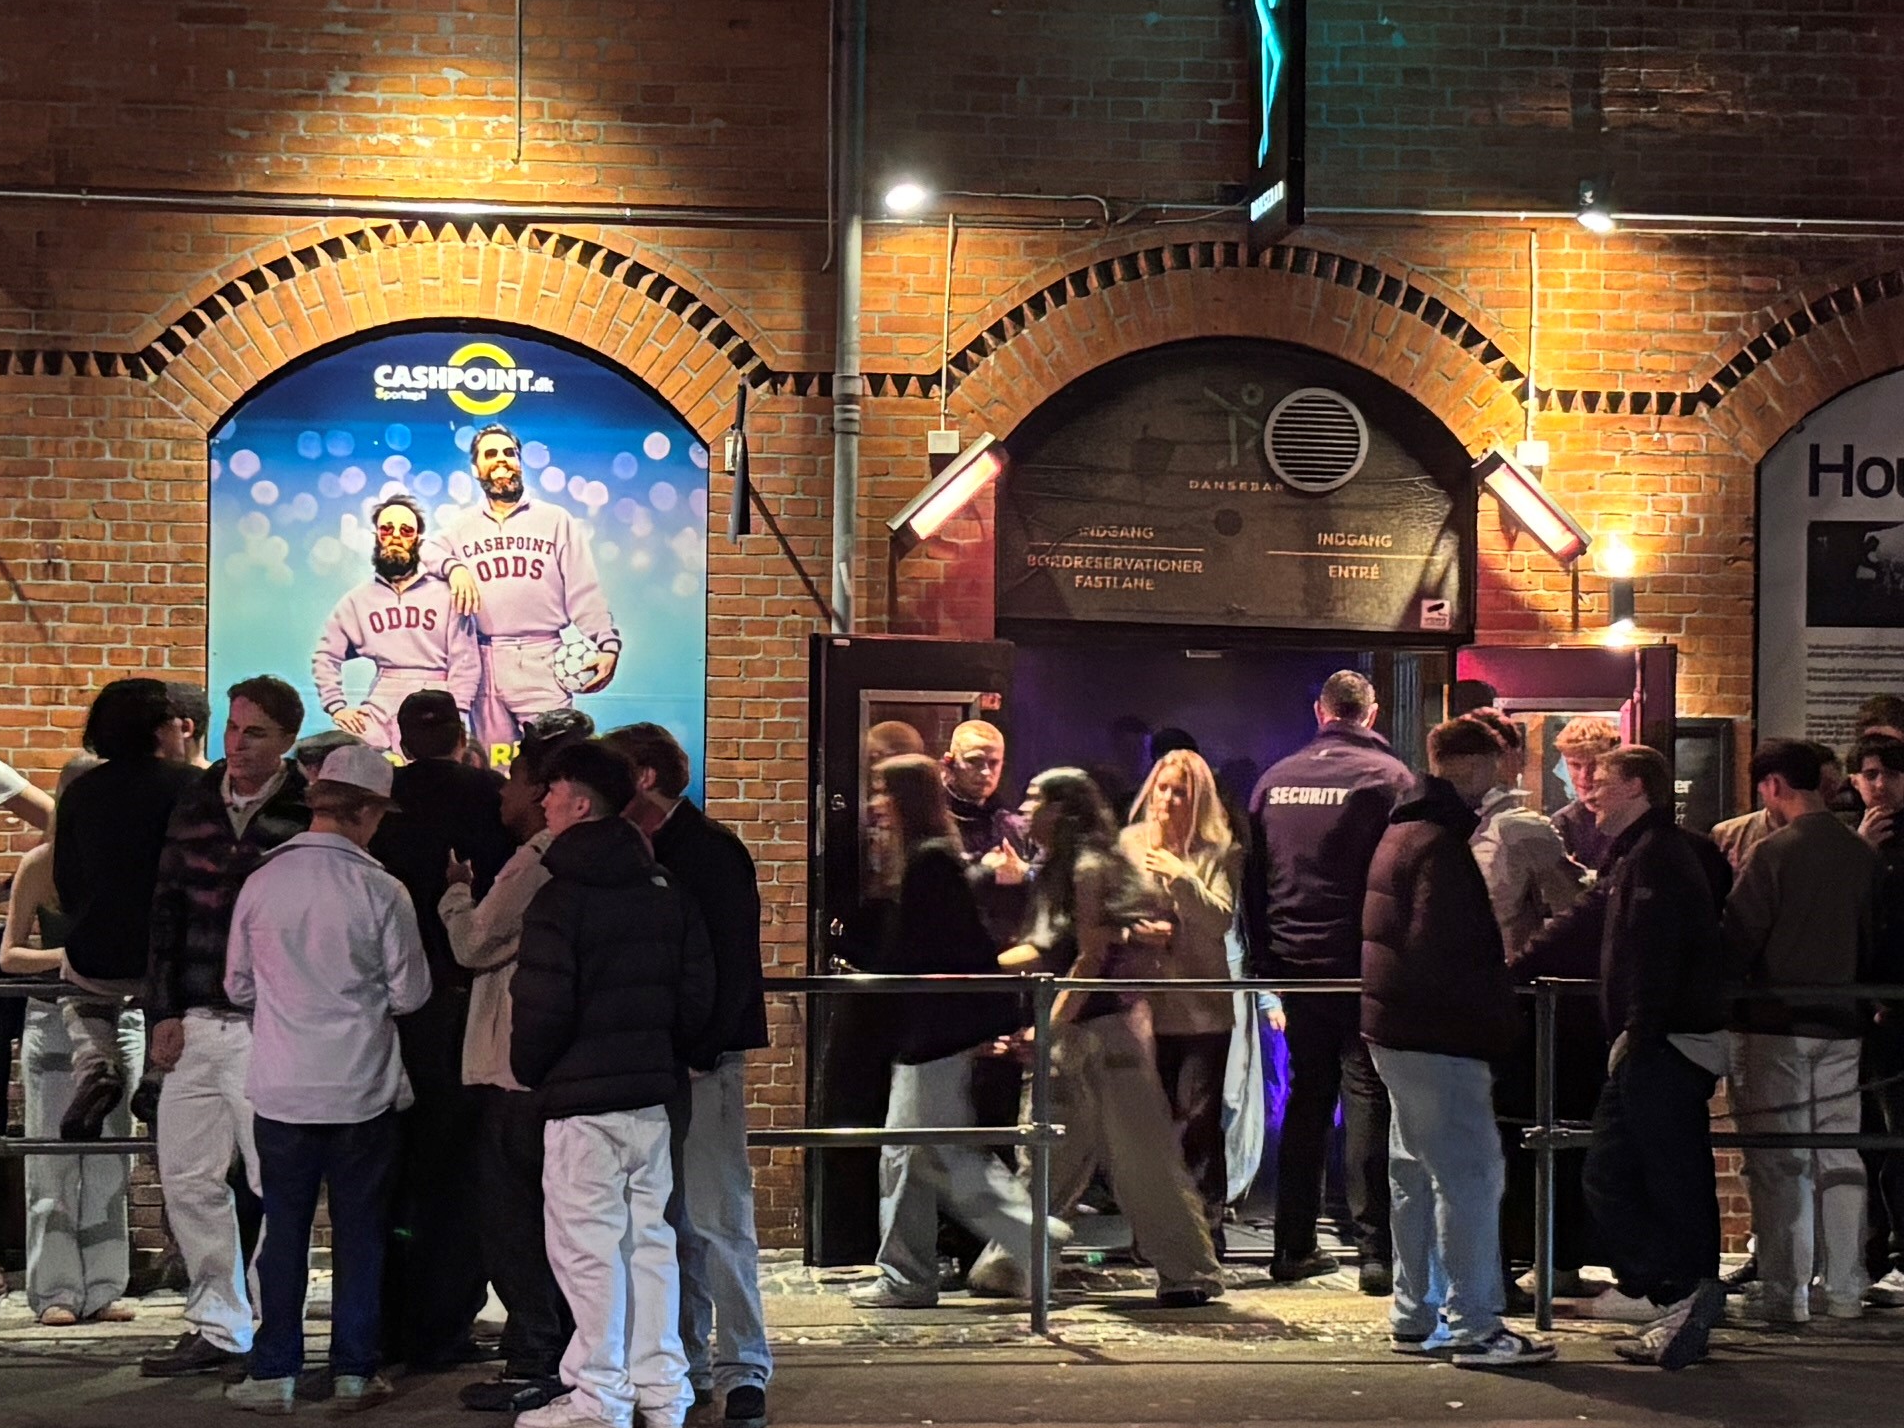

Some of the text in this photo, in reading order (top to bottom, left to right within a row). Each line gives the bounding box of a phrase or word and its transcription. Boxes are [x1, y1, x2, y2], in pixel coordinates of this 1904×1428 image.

[1188, 479, 1285, 493] DANSEBAR
[462, 536, 556, 559] CASHPOINT
[1317, 532, 1393, 549] INDGANG
[476, 556, 545, 583] ODDS
[1328, 563, 1381, 580] ENTRÉ
[1074, 574, 1156, 591] FASTLANE
[369, 605, 438, 634] ODDS
[1269, 786, 1349, 805] SECURITY
